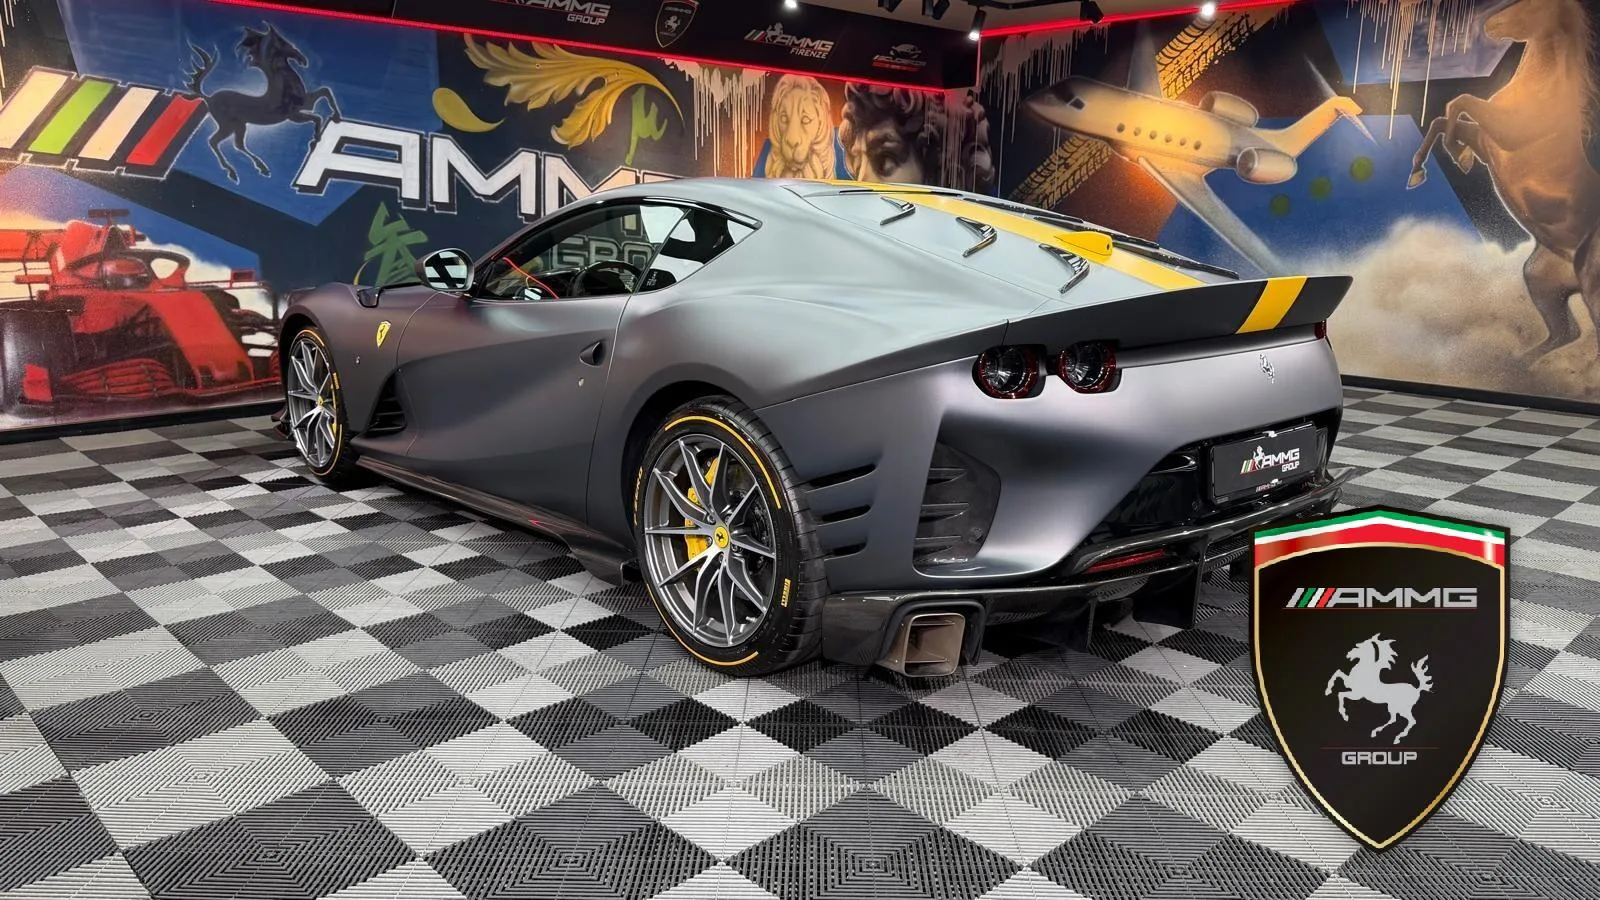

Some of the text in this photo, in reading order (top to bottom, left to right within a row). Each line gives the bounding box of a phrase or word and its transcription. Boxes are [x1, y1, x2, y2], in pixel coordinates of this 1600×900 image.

[567, 13, 606, 25] GROUP
[773, 34, 834, 52] AMMG
[790, 47, 829, 59] FIRENZE
[292, 119, 684, 228] AMM
[552, 236, 654, 271] GRO
[1261, 447, 1300, 469] AMMG
[1281, 461, 1300, 473] GROUP
